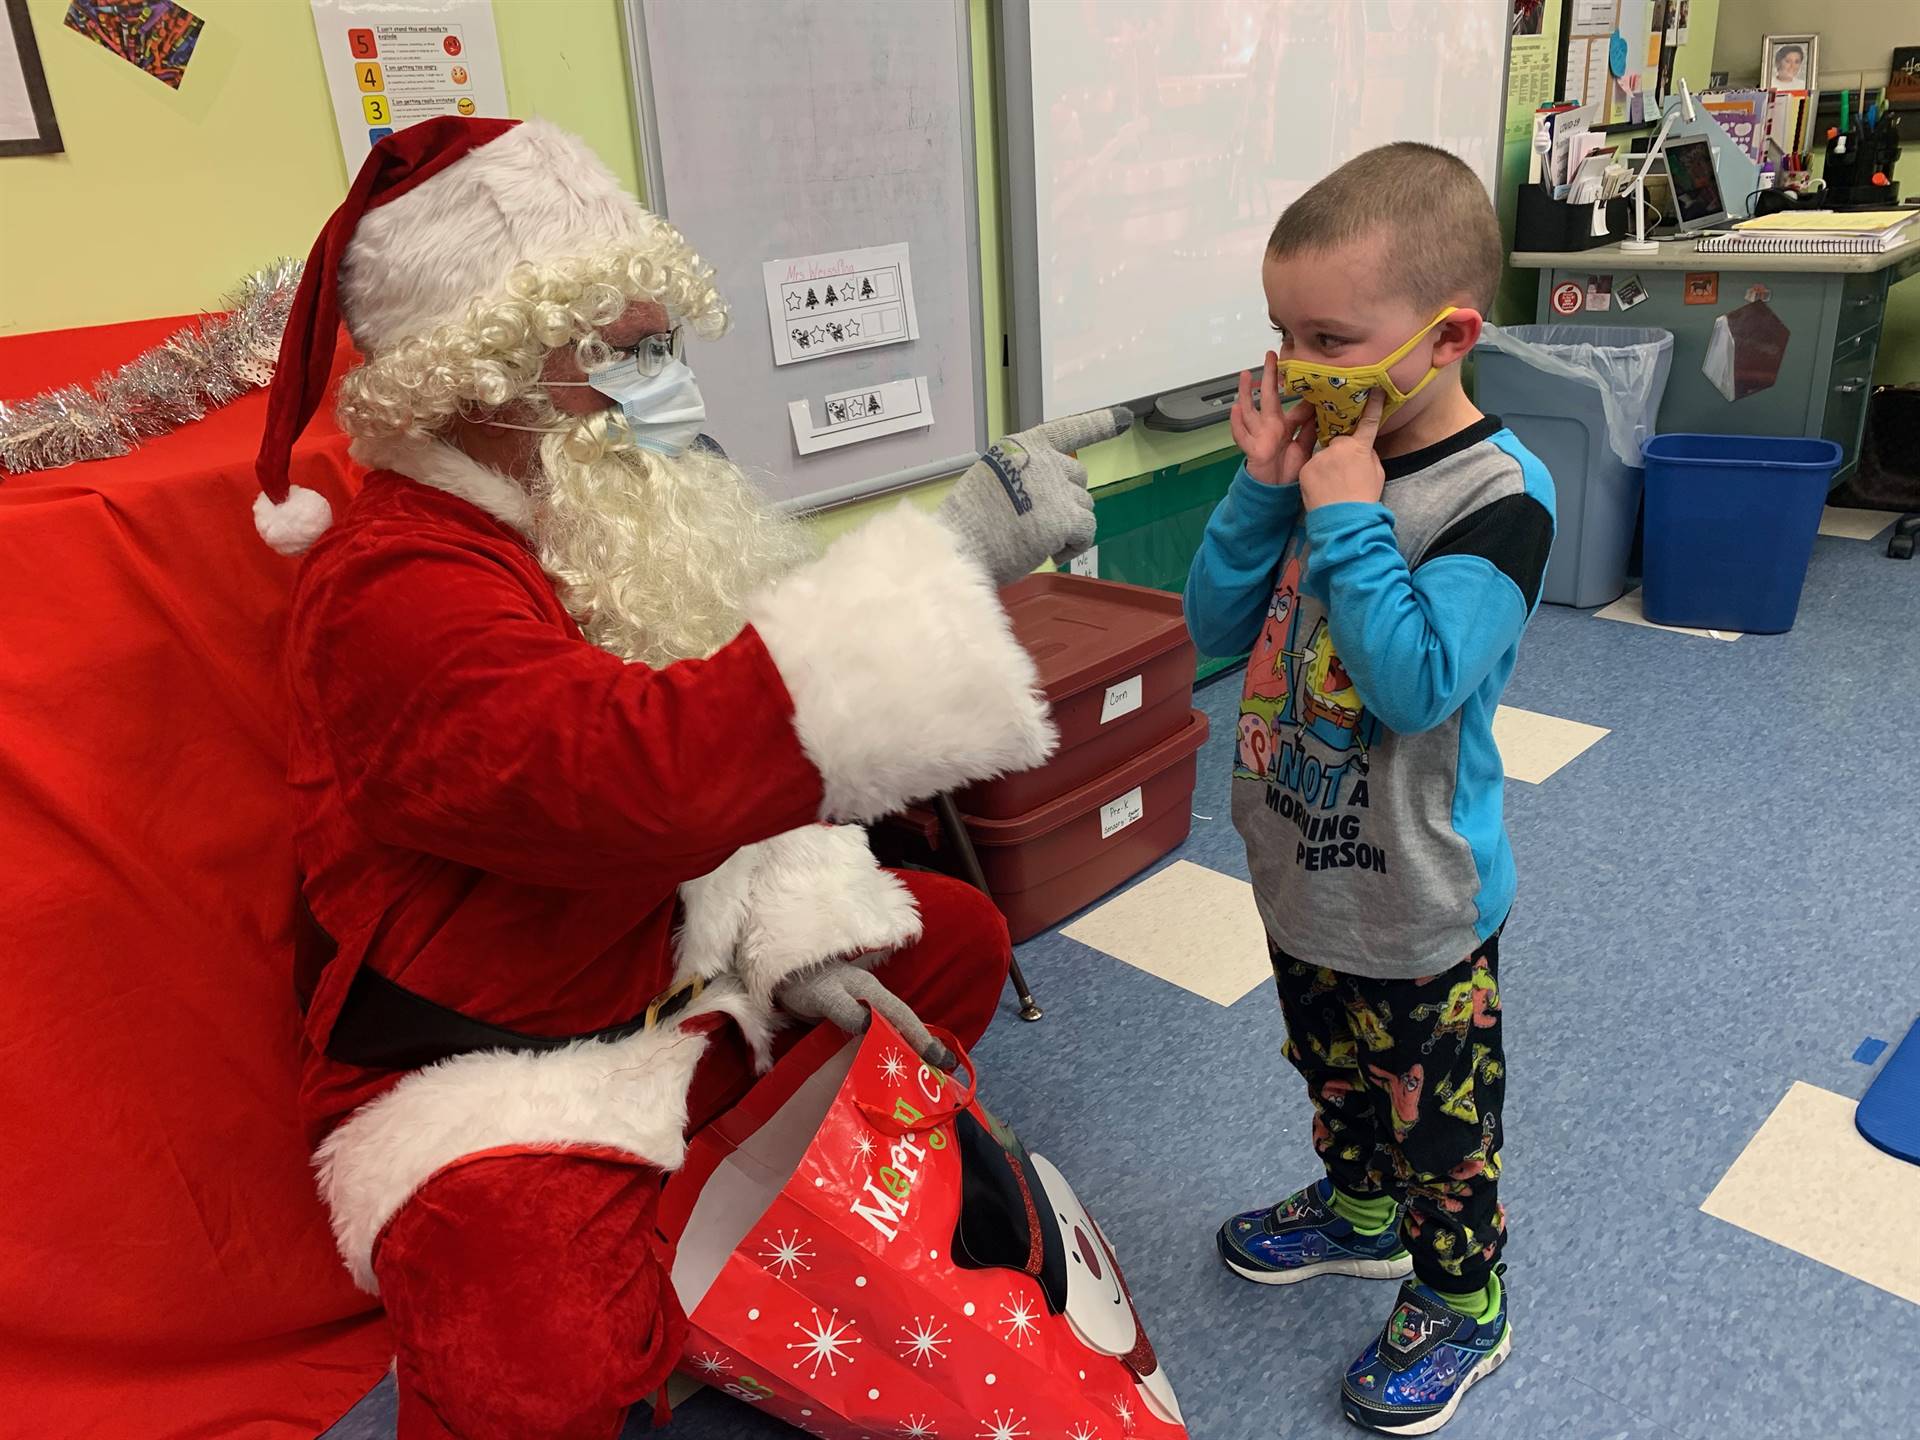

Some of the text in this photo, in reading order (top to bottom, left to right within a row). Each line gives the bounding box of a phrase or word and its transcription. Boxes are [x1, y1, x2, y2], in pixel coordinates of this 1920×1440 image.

[356, 35, 369, 54] 5
[364, 68, 377, 87] 4
[370, 101, 383, 120] 3
[1110, 690, 1128, 706] Corn
[1276, 740, 1370, 810] NOT A
[1265, 784, 1361, 842] MORNING
[1296, 841, 1387, 875] PERSON
[850, 1097, 947, 1243] Merry
